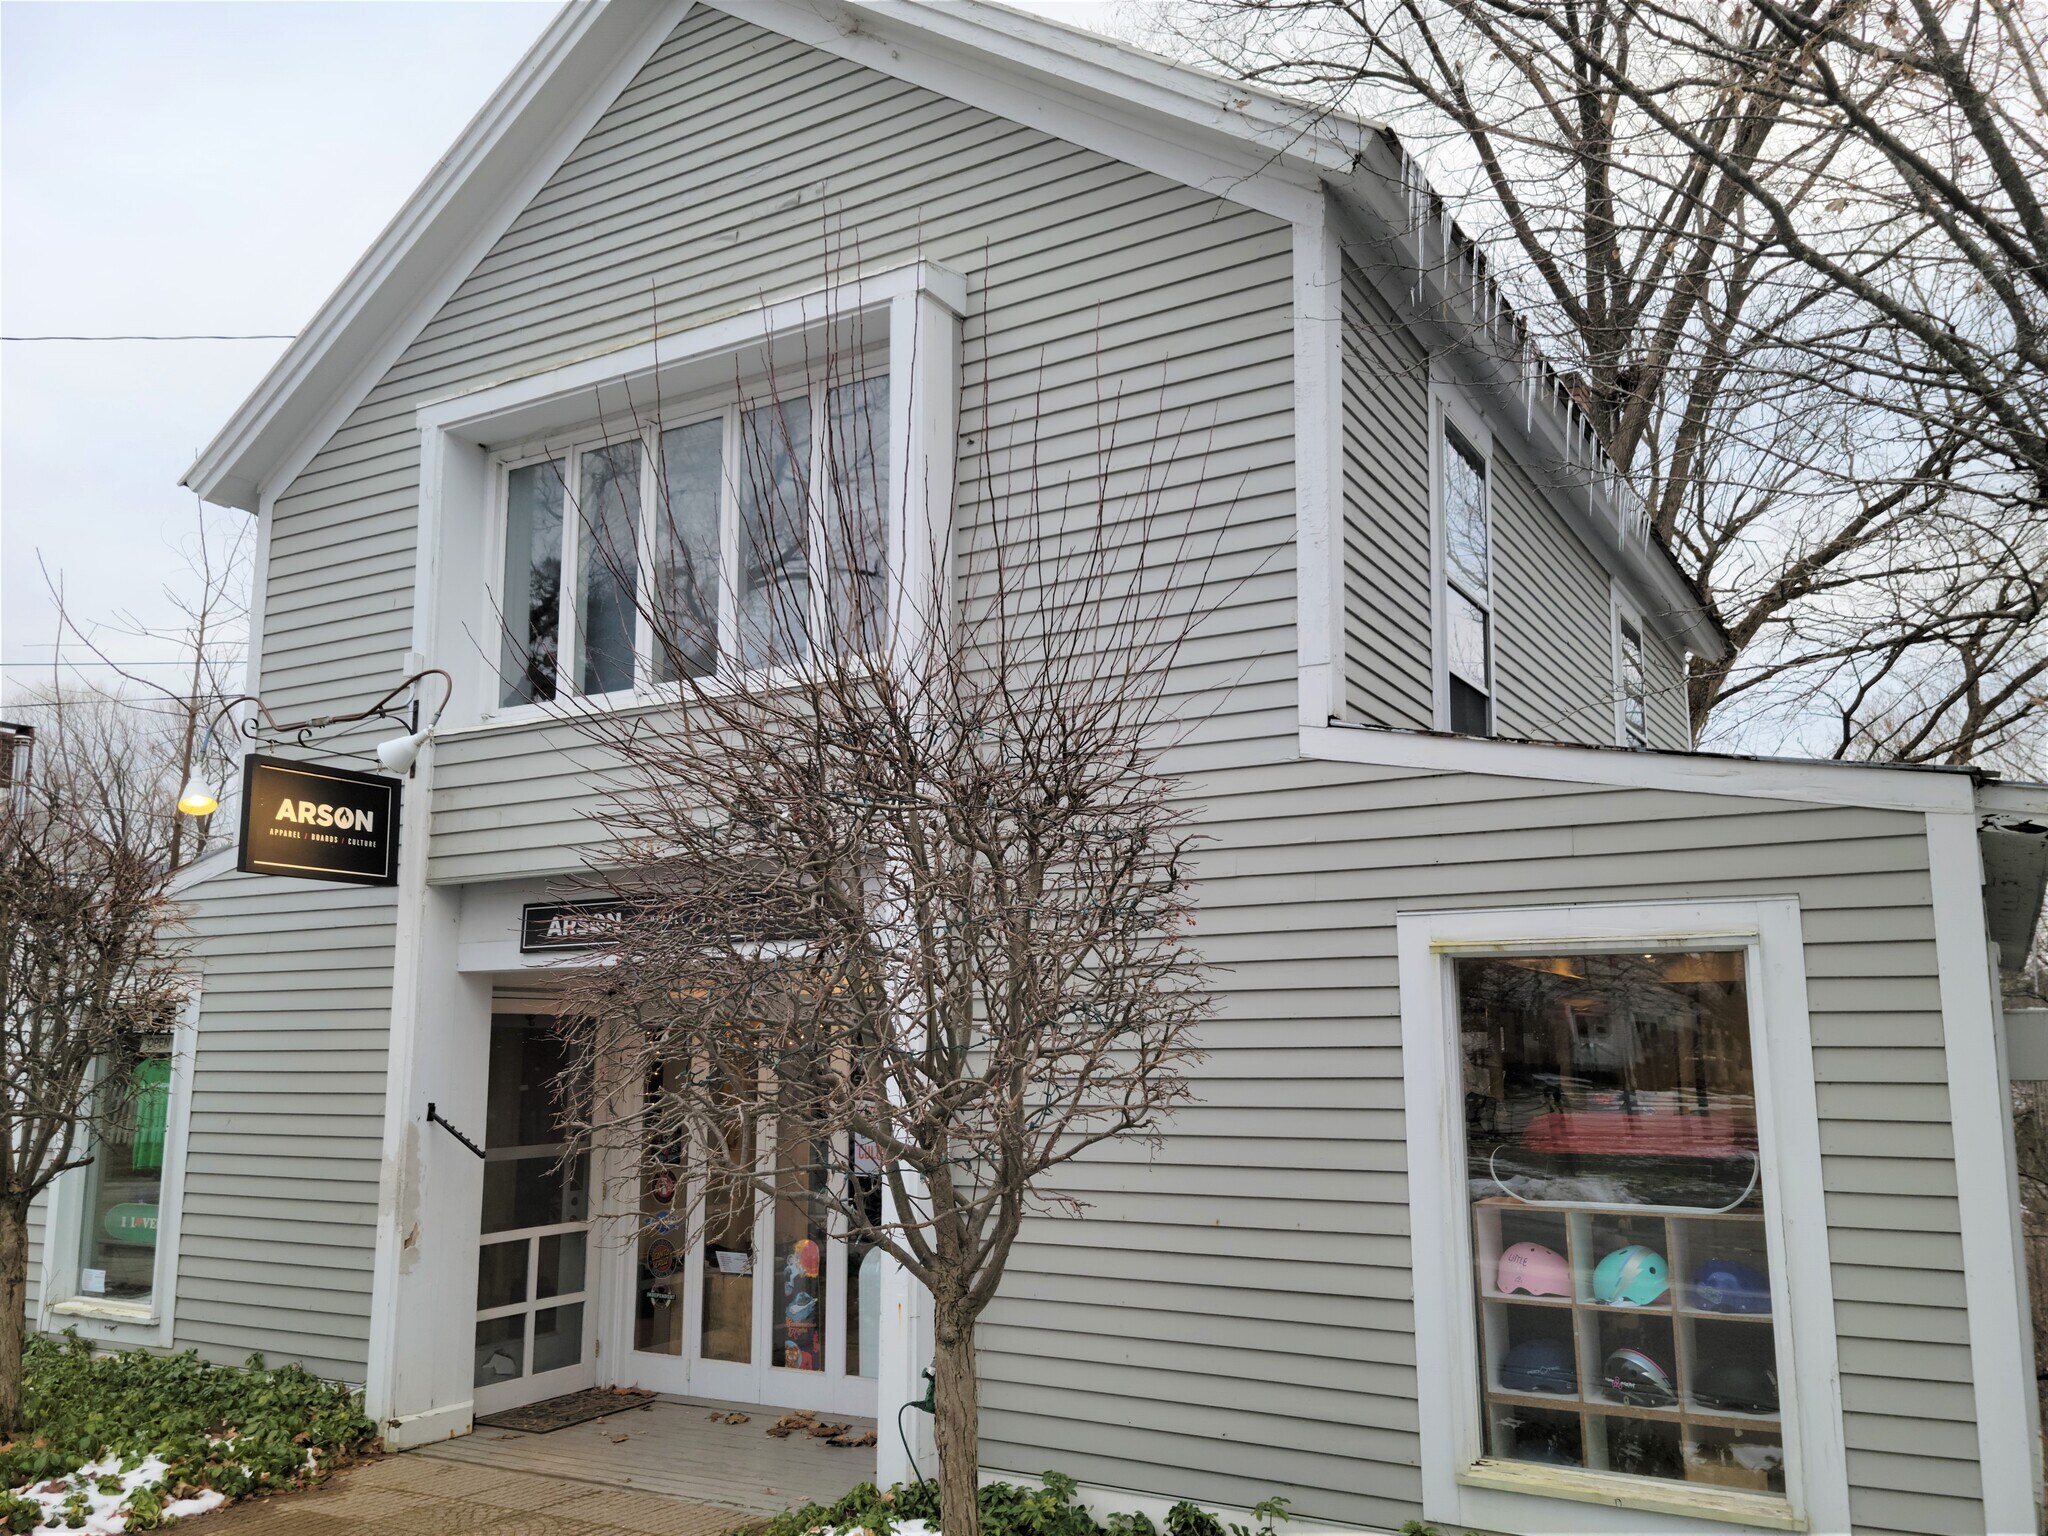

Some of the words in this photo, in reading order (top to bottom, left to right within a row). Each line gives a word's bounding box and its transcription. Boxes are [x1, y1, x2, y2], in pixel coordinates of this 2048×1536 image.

[275, 798, 374, 832] ARSON
[269, 828, 301, 839] APPAREL
[311, 833, 338, 844] BOARDS
[347, 838, 377, 848] CULTURE
[1508, 1253, 1528, 1267] LITTLE
